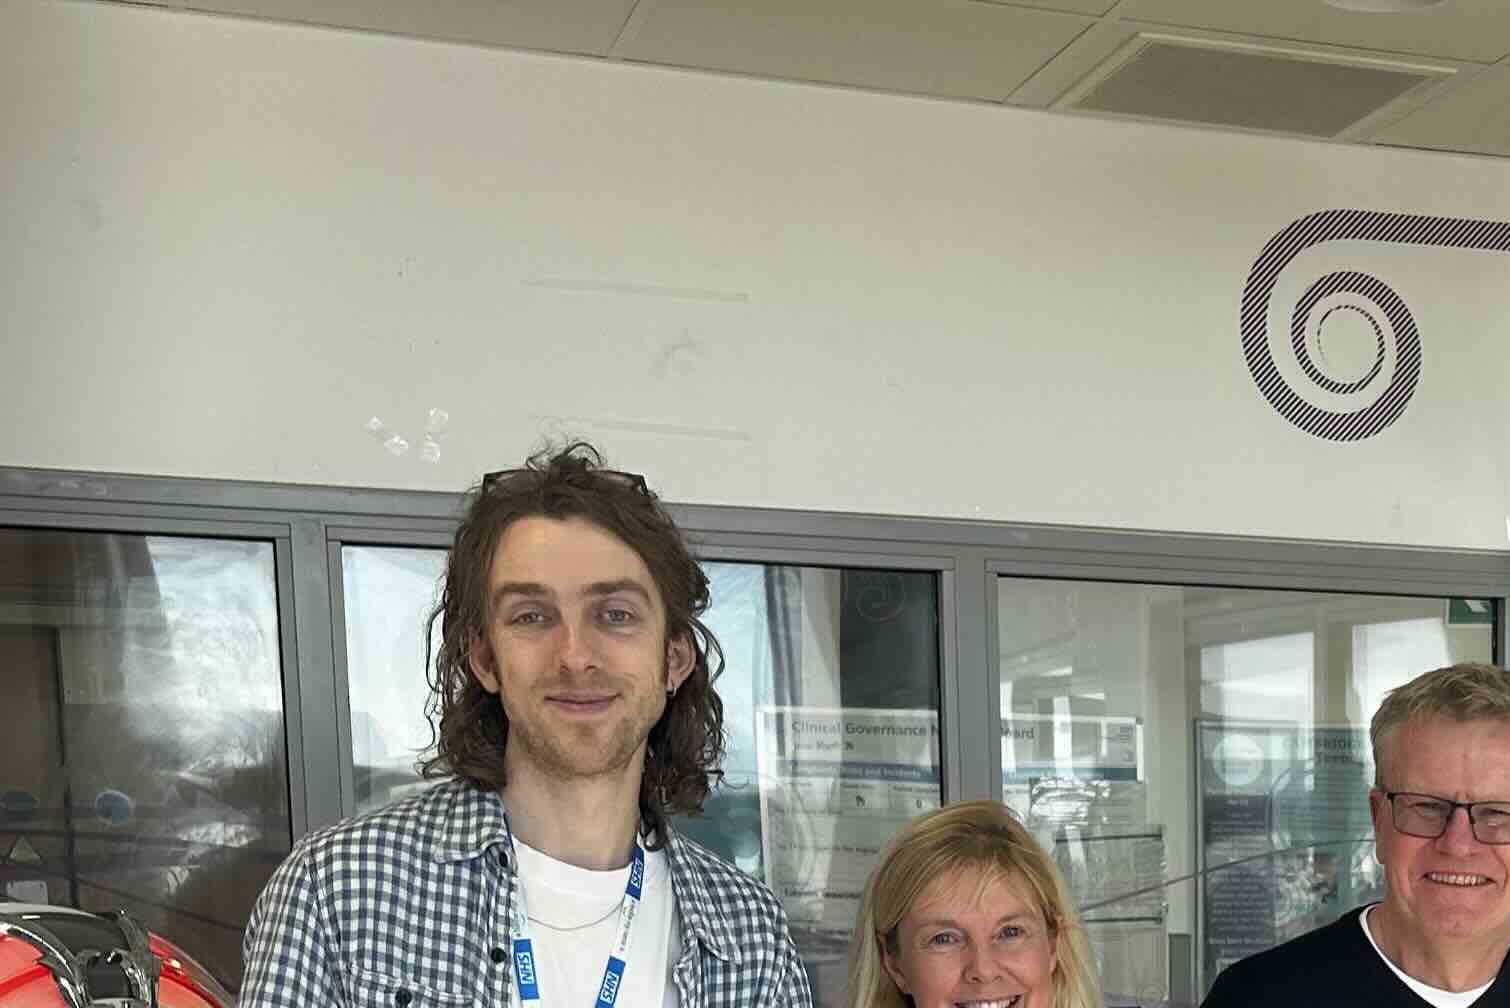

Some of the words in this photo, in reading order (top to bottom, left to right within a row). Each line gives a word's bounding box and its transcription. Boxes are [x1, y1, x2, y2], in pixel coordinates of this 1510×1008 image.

[791, 719, 841, 735] Clinical
[846, 722, 927, 737] Governance
[517, 951, 535, 985] NHS
[600, 972, 620, 1003] NHS
